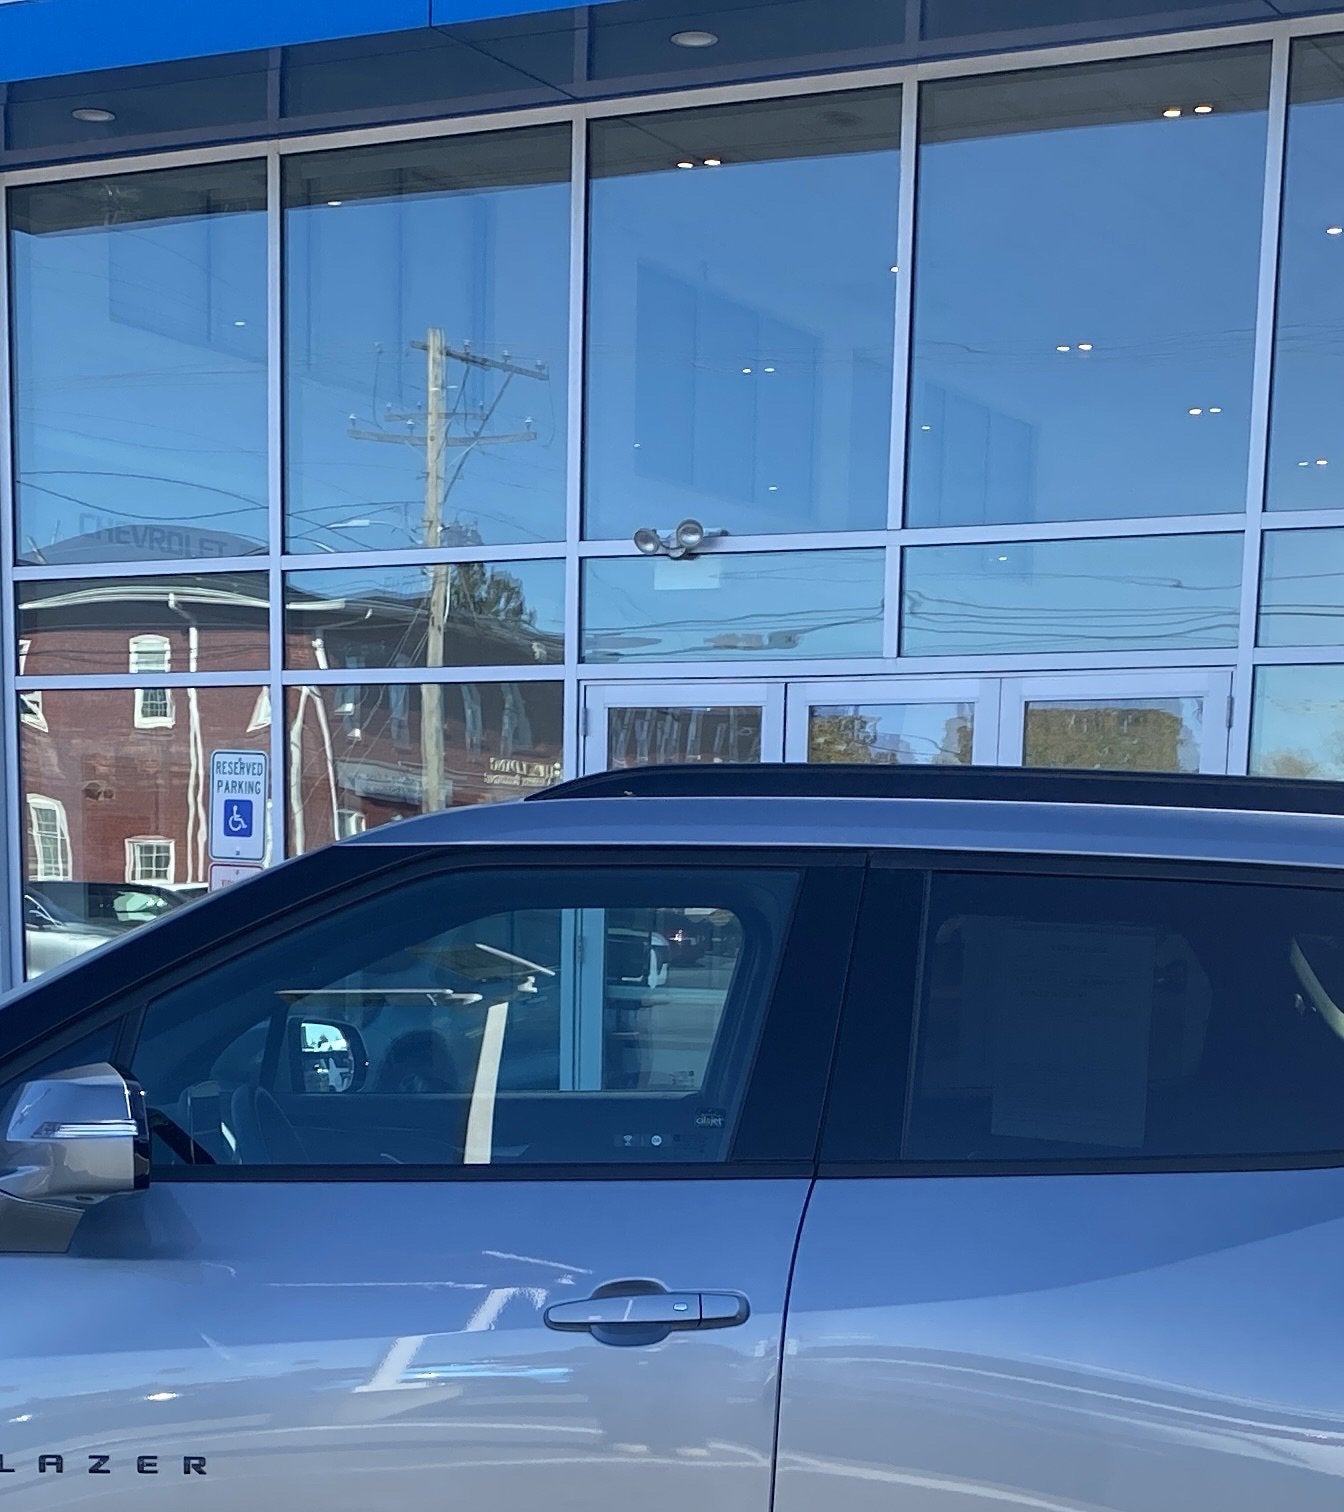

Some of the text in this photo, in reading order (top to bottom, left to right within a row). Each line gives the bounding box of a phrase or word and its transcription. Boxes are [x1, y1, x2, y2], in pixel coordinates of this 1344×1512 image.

[79, 512, 227, 557] CHEVROLET
[216, 761, 263, 776] RESERVED
[217, 780, 261, 794] PARKING
